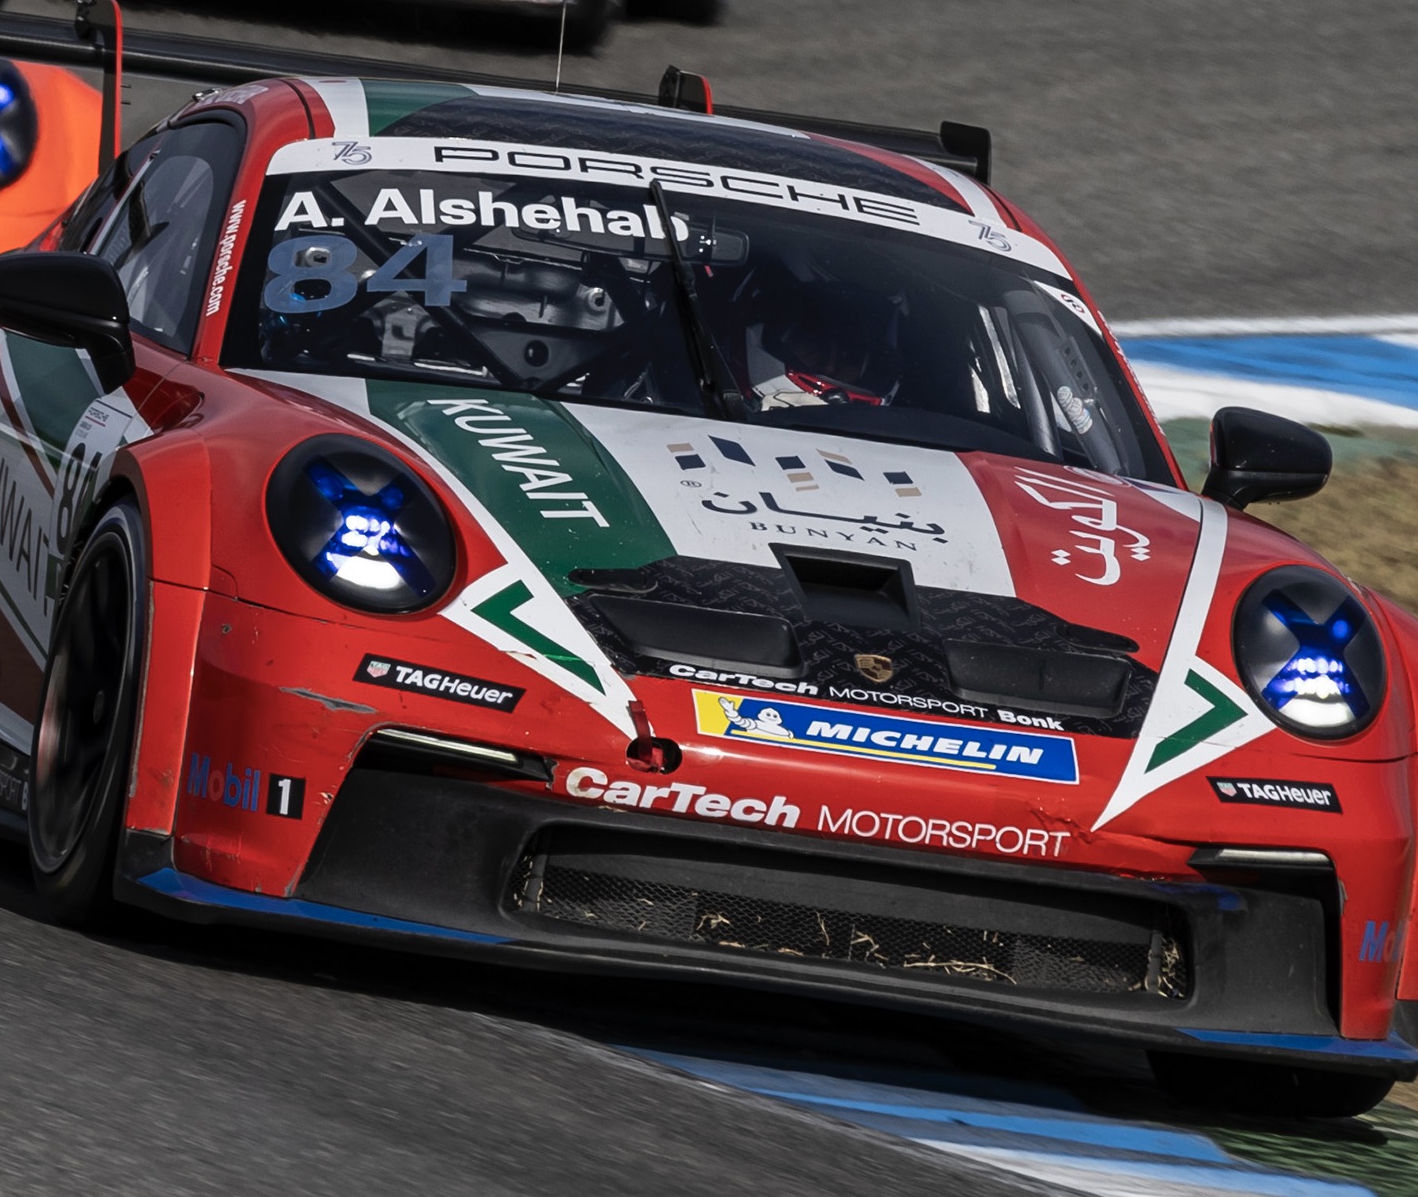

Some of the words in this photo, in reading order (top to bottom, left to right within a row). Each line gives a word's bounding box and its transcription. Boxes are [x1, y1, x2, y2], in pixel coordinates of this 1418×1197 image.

[274, 190, 345, 231] A.
[364, 188, 689, 243] Alshehab
[433, 145, 920, 226] PORSCHE
[263, 233, 468, 313] 84
[426, 399, 610, 527] KUWAIT
[749, 522, 918, 552] BUNYAN
[668, 663, 819, 695] CarTech
[828, 686, 988, 718] MOTORSPORT
[997, 709, 1064, 732] Bonk
[806, 721, 1044, 764] MICHELIN
[187, 753, 262, 813] Mobil
[276, 777, 291, 815] 1
[566, 766, 801, 829] CarTech
[817, 805, 1071, 858] MOTORSPORT
